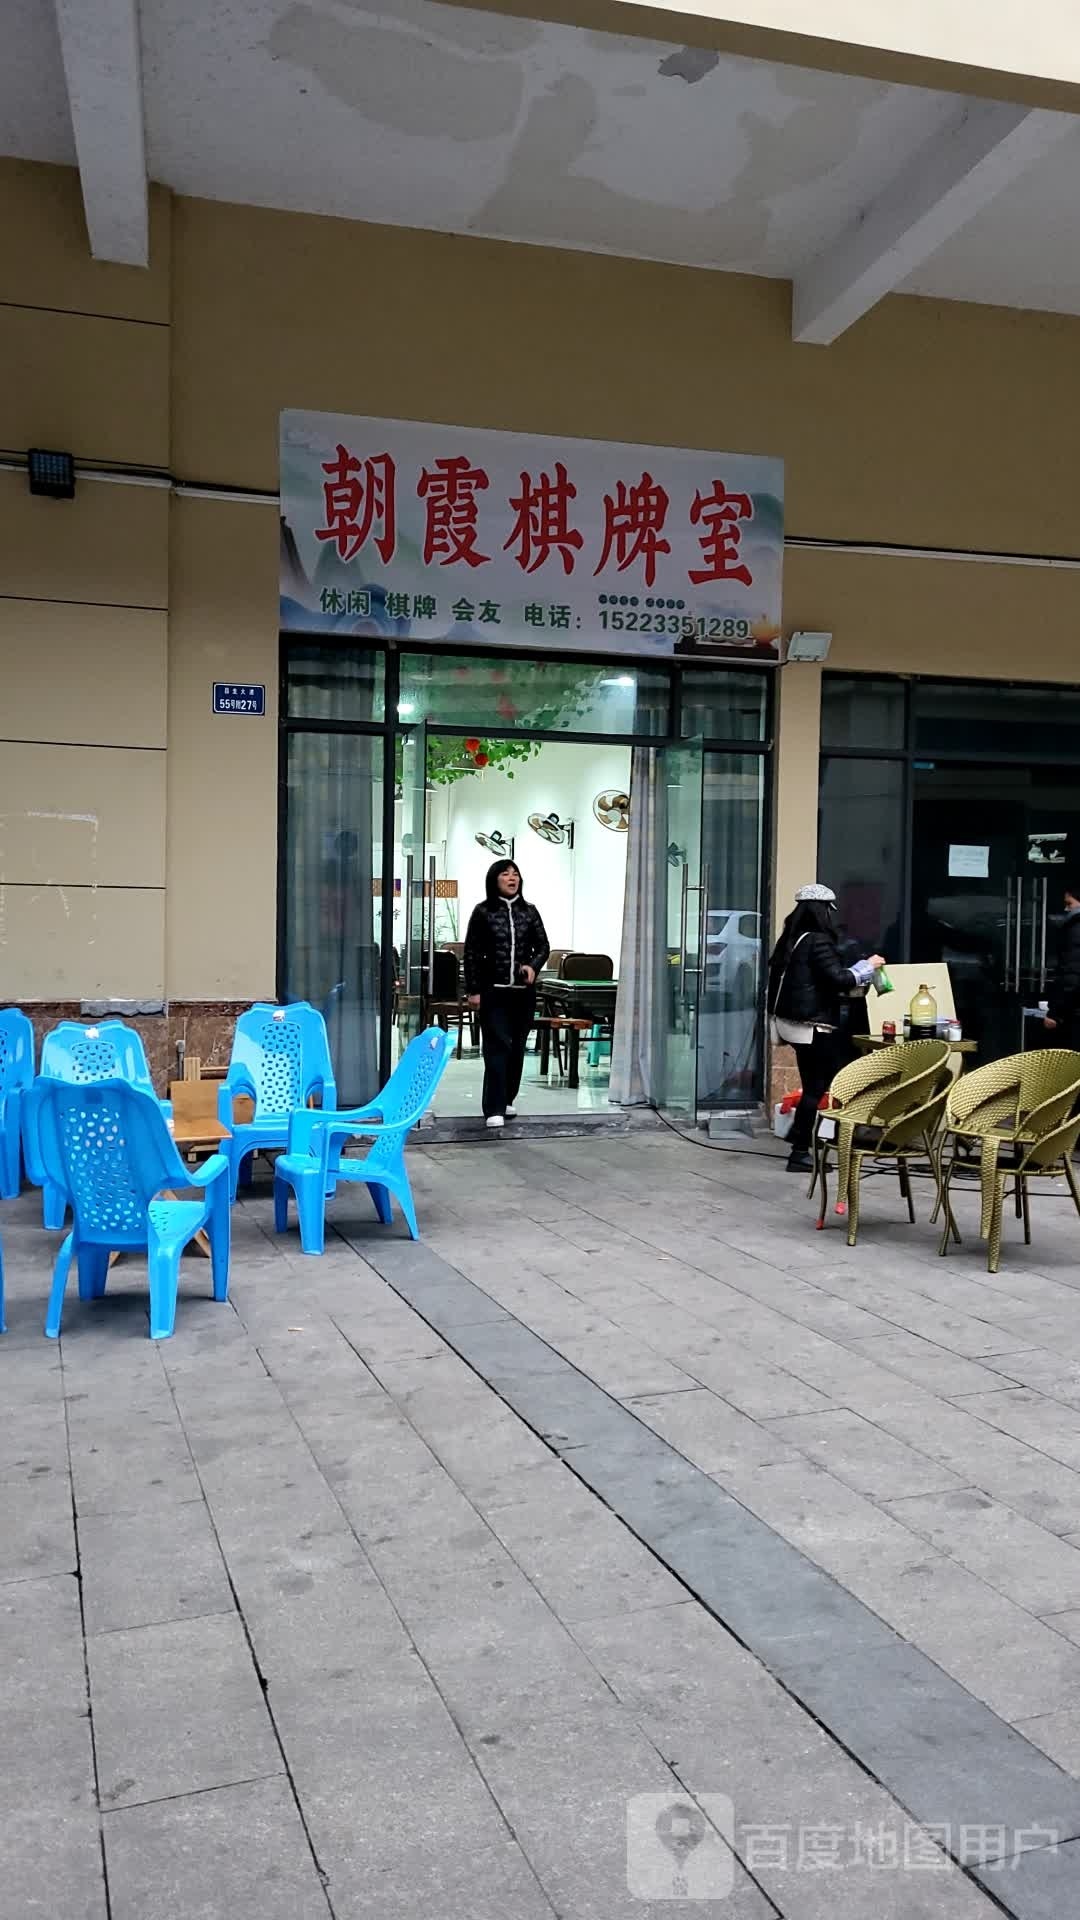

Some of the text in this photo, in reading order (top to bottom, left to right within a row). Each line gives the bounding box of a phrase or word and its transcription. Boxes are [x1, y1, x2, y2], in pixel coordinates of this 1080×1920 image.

[313, 443, 752, 587] 朝霞棋牌室
[319, 588, 371, 614] 休闲
[385, 592, 437, 619] 棋牌
[452, 597, 502, 624] 会友
[599, 610, 749, 638] 15223351289
